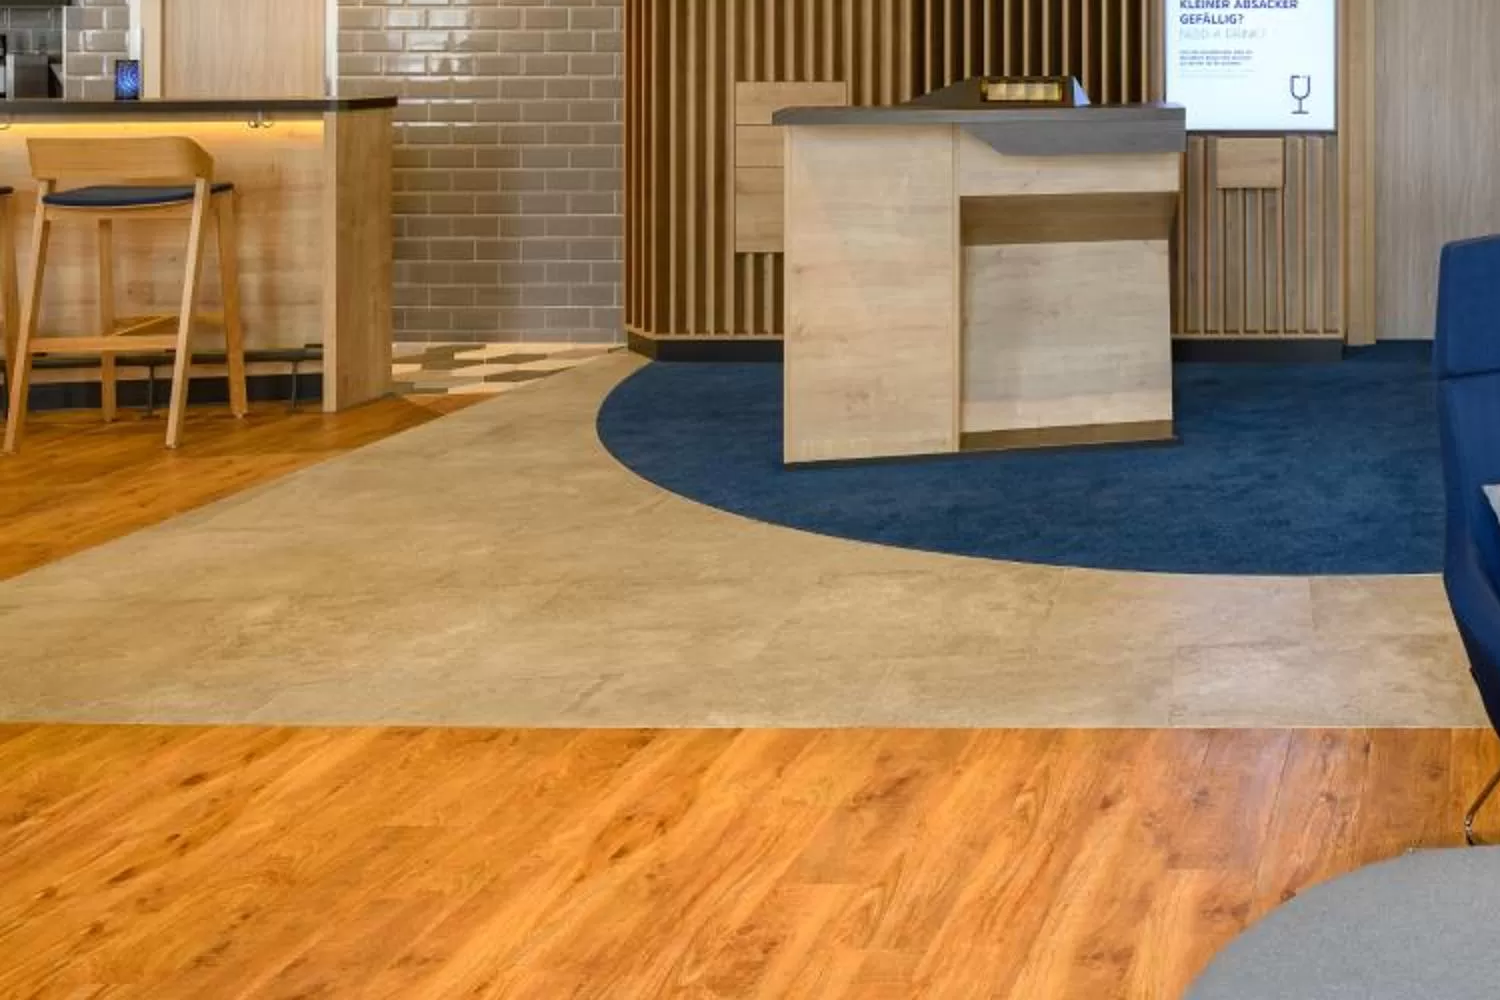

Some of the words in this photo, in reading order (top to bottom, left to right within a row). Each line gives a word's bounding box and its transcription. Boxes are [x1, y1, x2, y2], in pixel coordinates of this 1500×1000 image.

[1179, 0, 1230, 9] KLEINER
[1233, 0, 1299, 9] ABSACKER
[1179, 12, 1245, 25] GEFÄLLIG?
